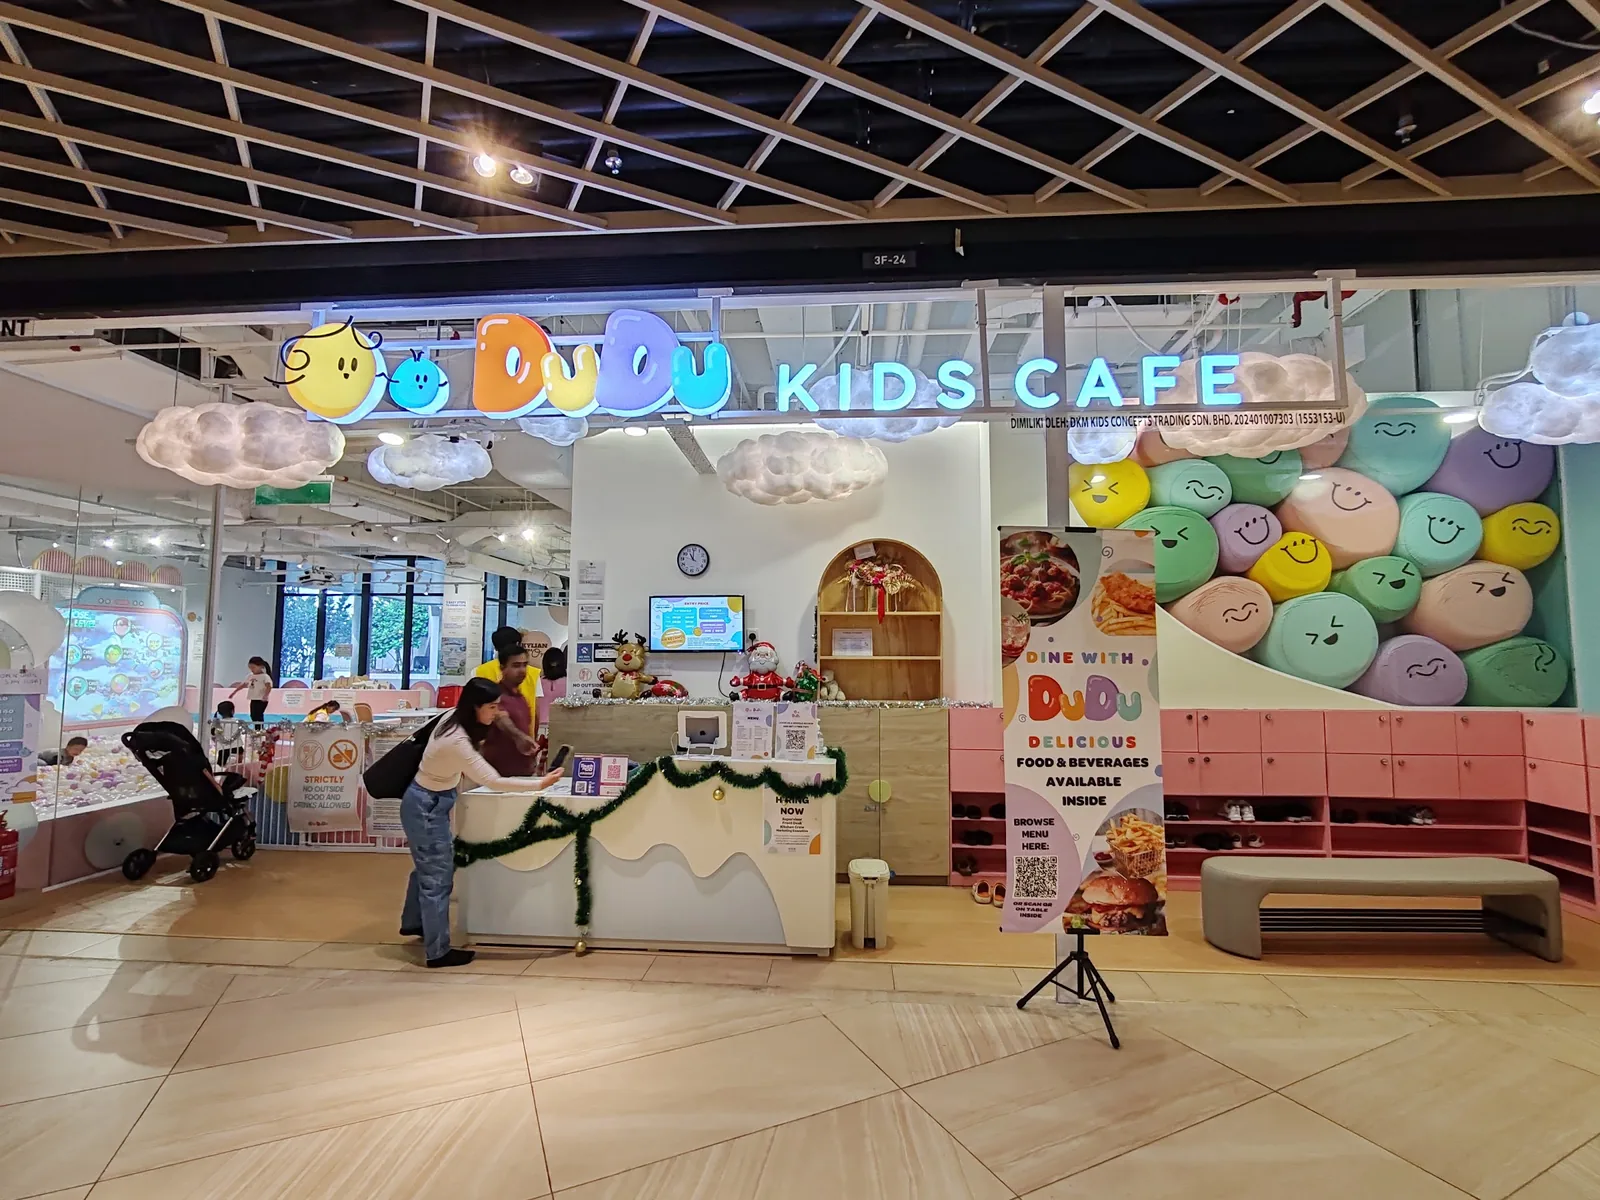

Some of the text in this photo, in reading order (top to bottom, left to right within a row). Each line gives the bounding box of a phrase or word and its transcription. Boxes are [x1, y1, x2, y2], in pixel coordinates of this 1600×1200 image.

[874, 255, 906, 265] 3F-24
[777, 354, 1243, 413] KIDS CAFE
[1010, 411, 1346, 429] DIMILIKI OLEH: DKM KIDS CONCEPTS TRADING SDN. BHD. 202401007303 (1553153-U)
[1026, 651, 1133, 664] DINE WITH
[1028, 736, 1137, 749] DELICIOUS
[1016, 757, 1149, 768] FOOD & BEVERAGES
[304, 775, 344, 784] STRICTLY
[1046, 776, 1122, 787] AVAILABLE
[302, 785, 344, 793] NO OUTSIDE
[304, 793, 341, 801] FOOD AND
[775, 796, 810, 804] HRING
[1062, 795, 1107, 806] INSIDE
[293, 801, 351, 809] DRINKS ALLOWED
[780, 807, 804, 815] NOW
[1013, 818, 1055, 827] BROWSE
[1022, 830, 1049, 838] MENU
[1022, 842, 1050, 850] HERE:
